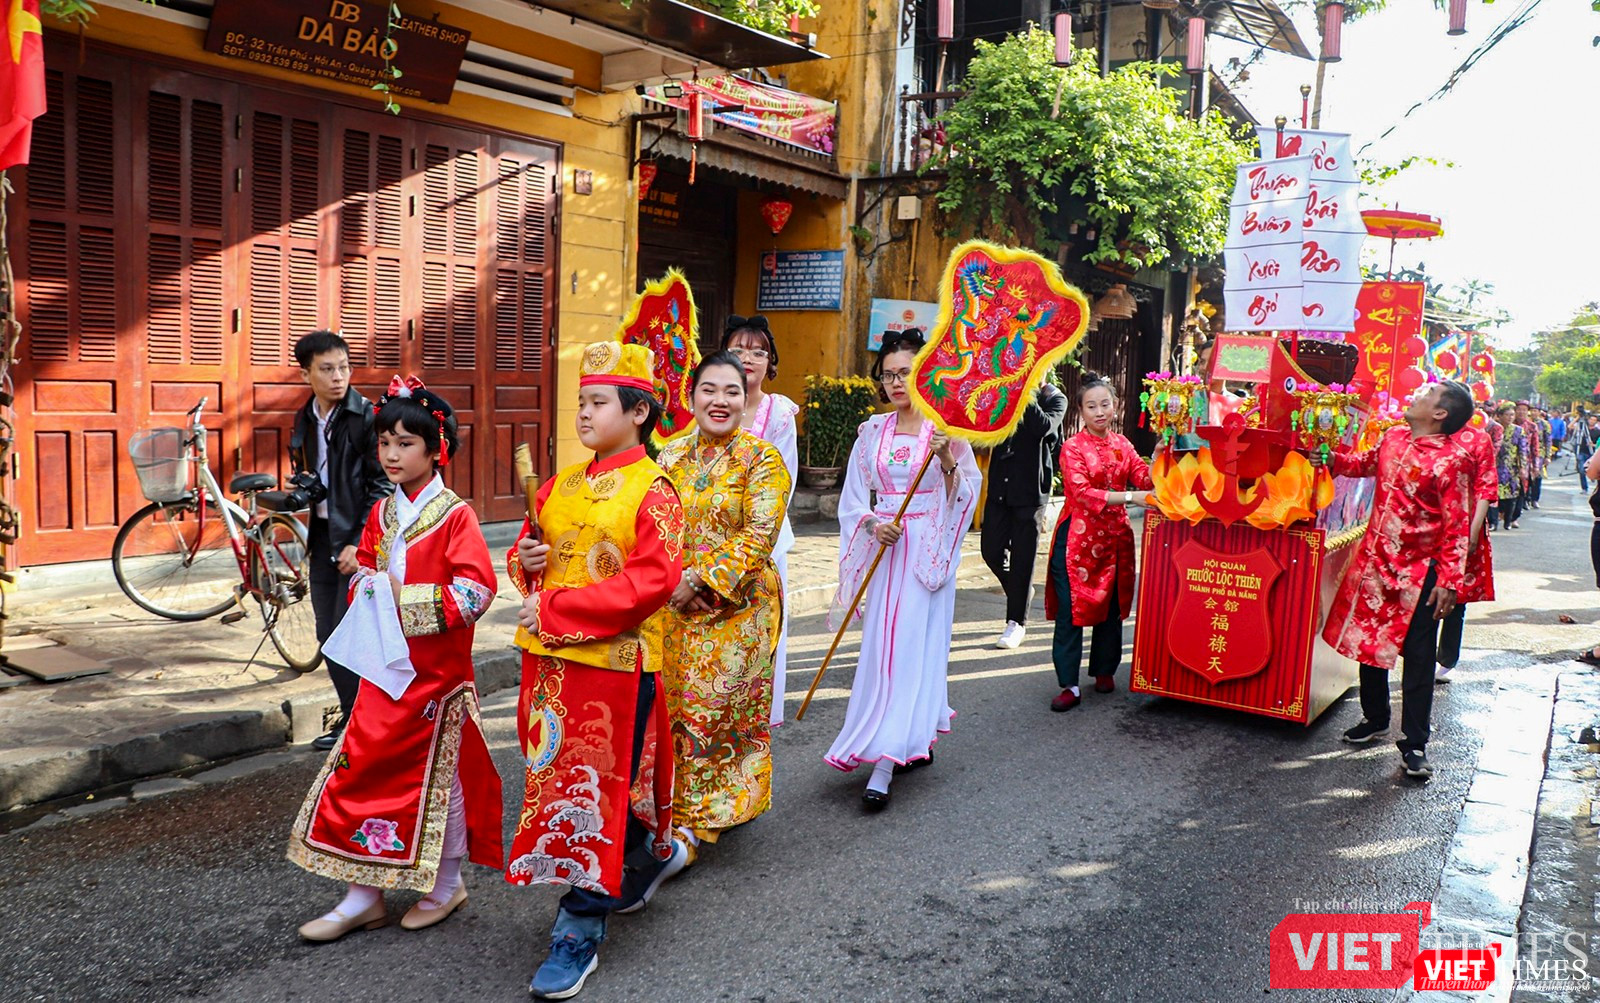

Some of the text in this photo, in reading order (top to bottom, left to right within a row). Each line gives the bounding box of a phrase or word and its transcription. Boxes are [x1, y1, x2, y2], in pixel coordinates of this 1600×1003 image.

[298, 16, 398, 60] DA BẢO
[439, 28, 466, 46] SHOP
[226, 32, 248, 46] ĐC:
[250, 38, 265, 50] 32
[289, 49, 308, 60] Phú
[313, 55, 328, 66] Hội
[329, 59, 342, 68] An
[248, 51, 272, 64] 0932
[273, 56, 290, 68] 539
[292, 60, 309, 72] 899
[762, 111, 792, 139] 2023
[1248, 166, 1298, 200] Thuận
[1204, 559, 1218, 569] HỘI
[1186, 567, 1262, 590] PHƯỚC LỘC THIÊN
[1189, 584, 1210, 594] THÀNH
[1212, 585, 1226, 596] PHỐ
[1227, 589, 1237, 597] ĐÀ
